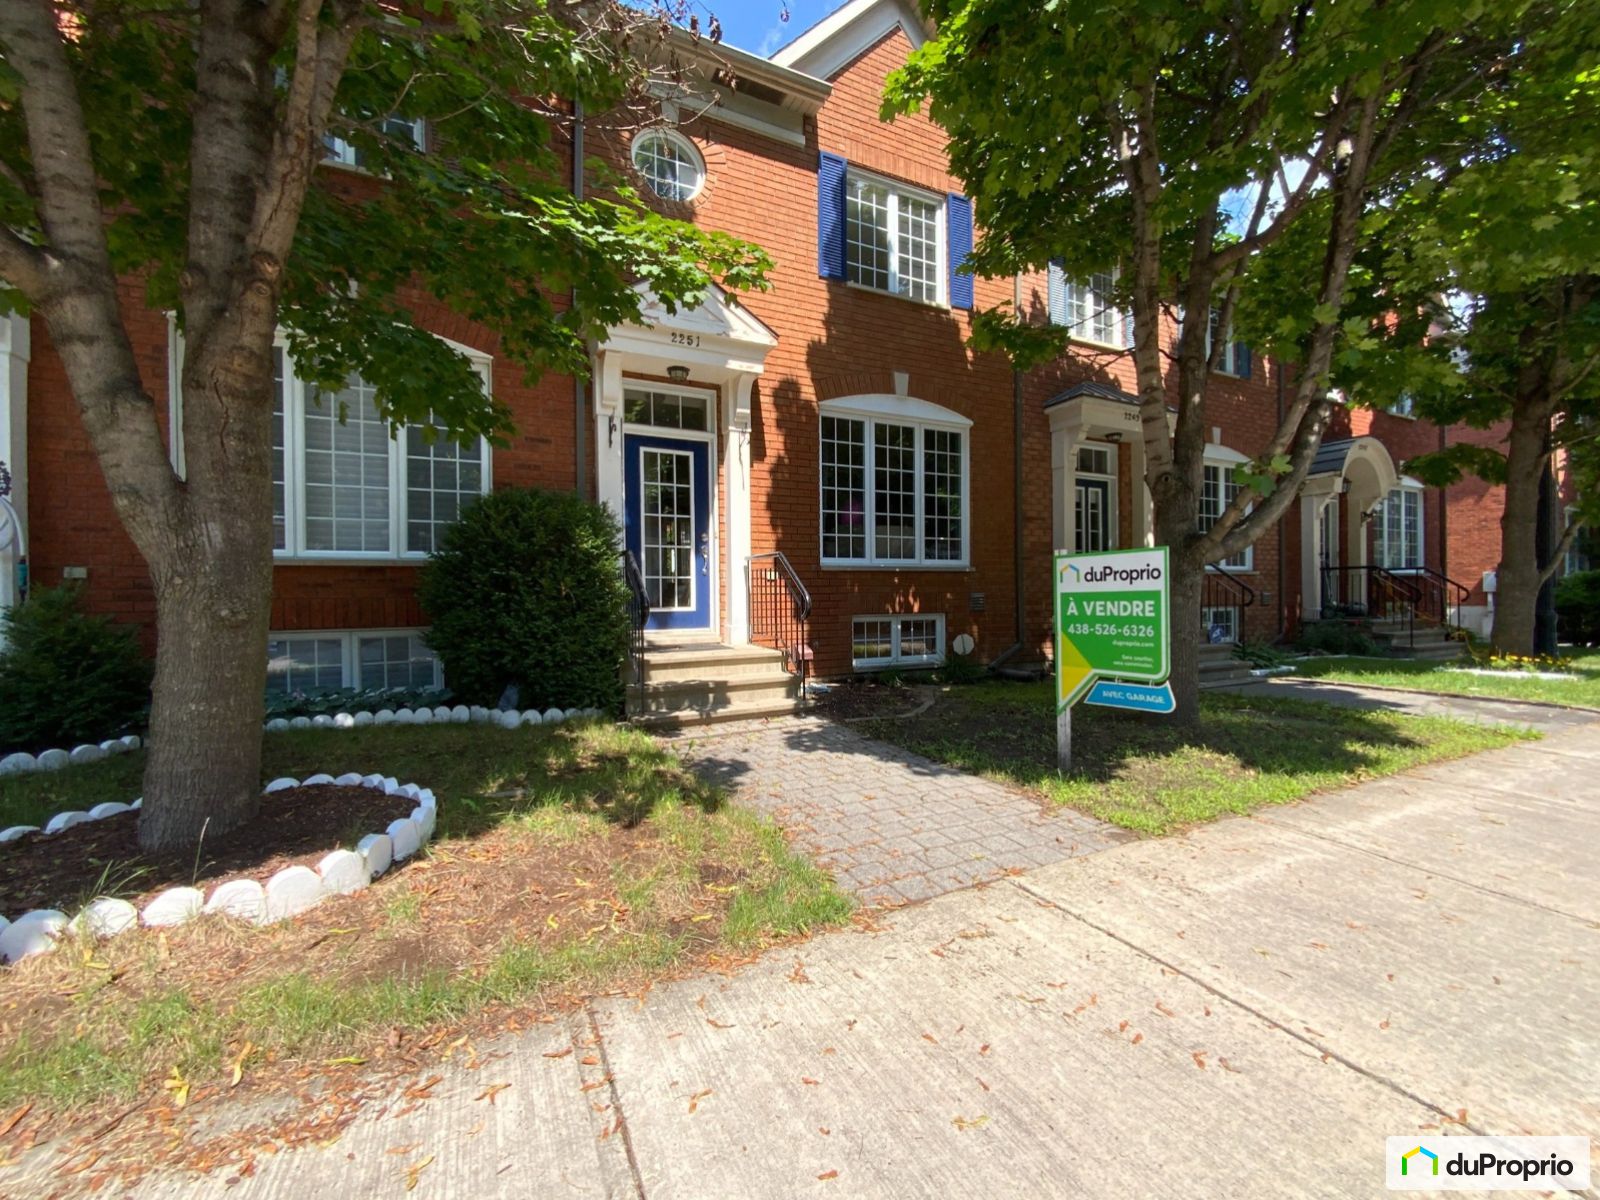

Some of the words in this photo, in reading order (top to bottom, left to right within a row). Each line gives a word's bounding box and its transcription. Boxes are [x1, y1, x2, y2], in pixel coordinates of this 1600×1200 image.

[671, 332, 700, 347] 2251
[1084, 563, 1161, 585] duProprio
[1067, 597, 1078, 616] À
[1083, 601, 1155, 616] VENDRE
[1068, 624, 1154, 637] 438-526-6326
[1102, 690, 1125, 699] AVEC
[1126, 692, 1165, 704] GARAGE
